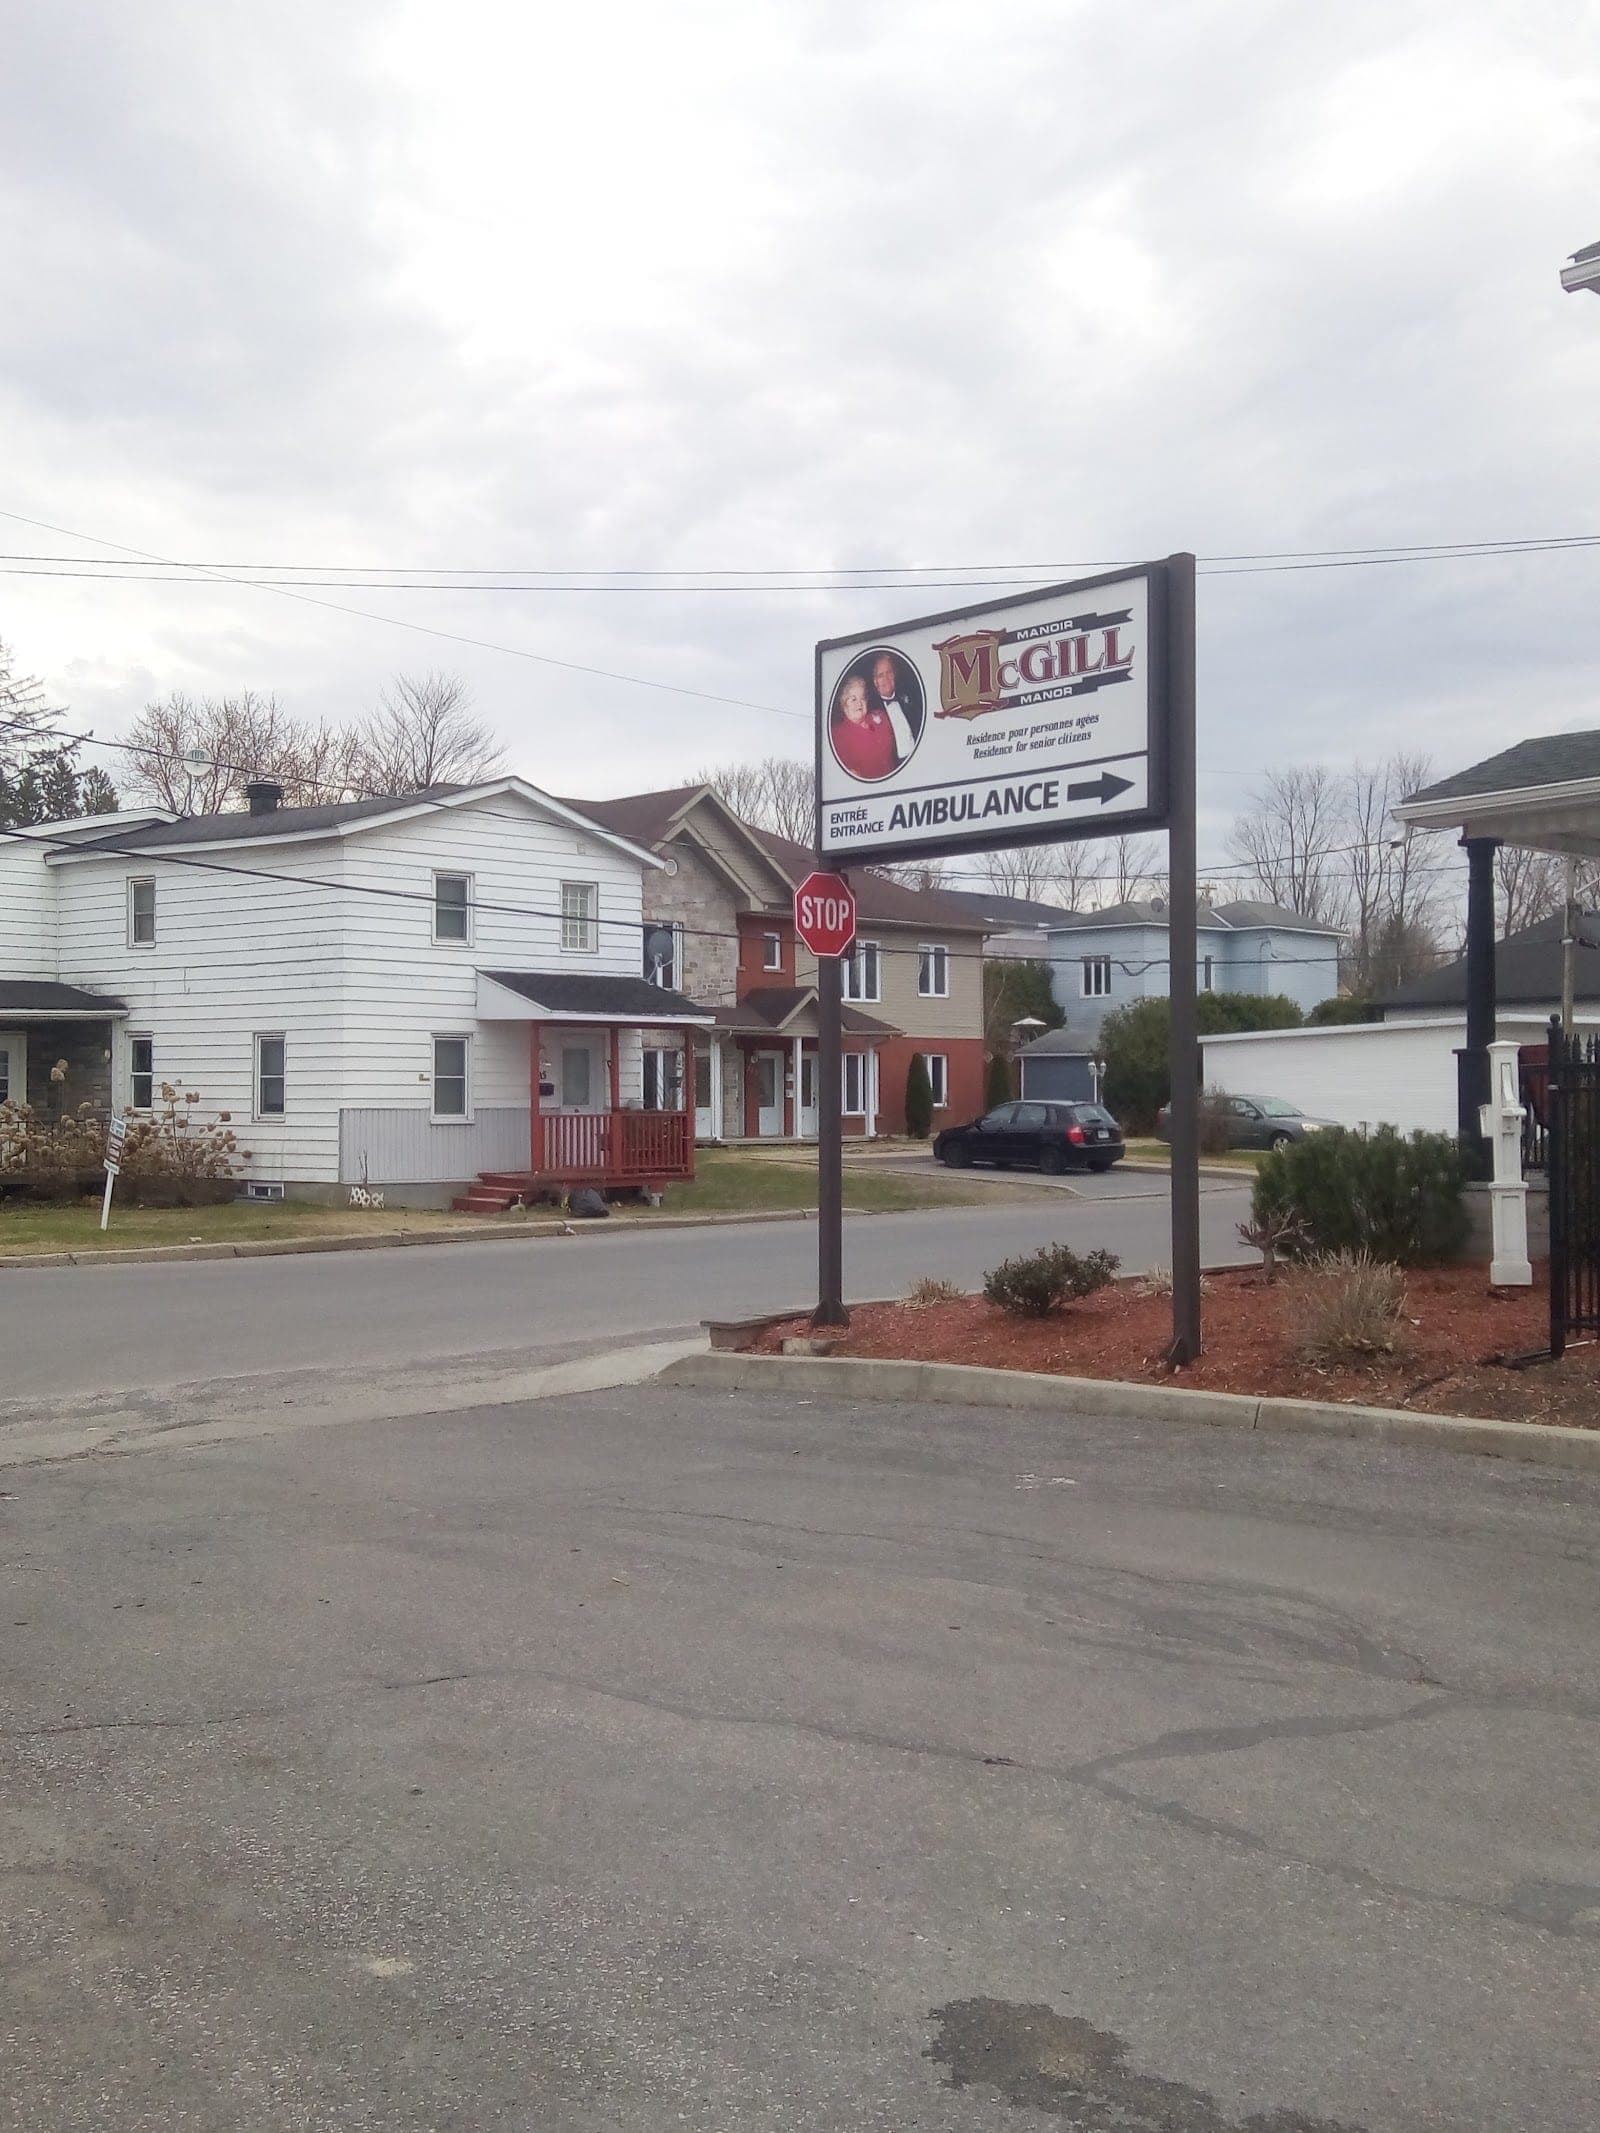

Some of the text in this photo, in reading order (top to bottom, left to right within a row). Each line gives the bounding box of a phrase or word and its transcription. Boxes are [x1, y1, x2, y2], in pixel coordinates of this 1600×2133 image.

[1017, 619, 1074, 640] MANOIR
[1020, 686, 1073, 705] MANOR
[1008, 727, 1029, 741] pour
[1030, 718, 1074, 737] personnes
[973, 730, 1092, 759] Residence for senior citizens
[830, 806, 868, 825] ENTRÉE
[888, 780, 1060, 831] AMBULANCE
[830, 821, 884, 838] ENTRANCE
[801, 895, 850, 931] STOP
